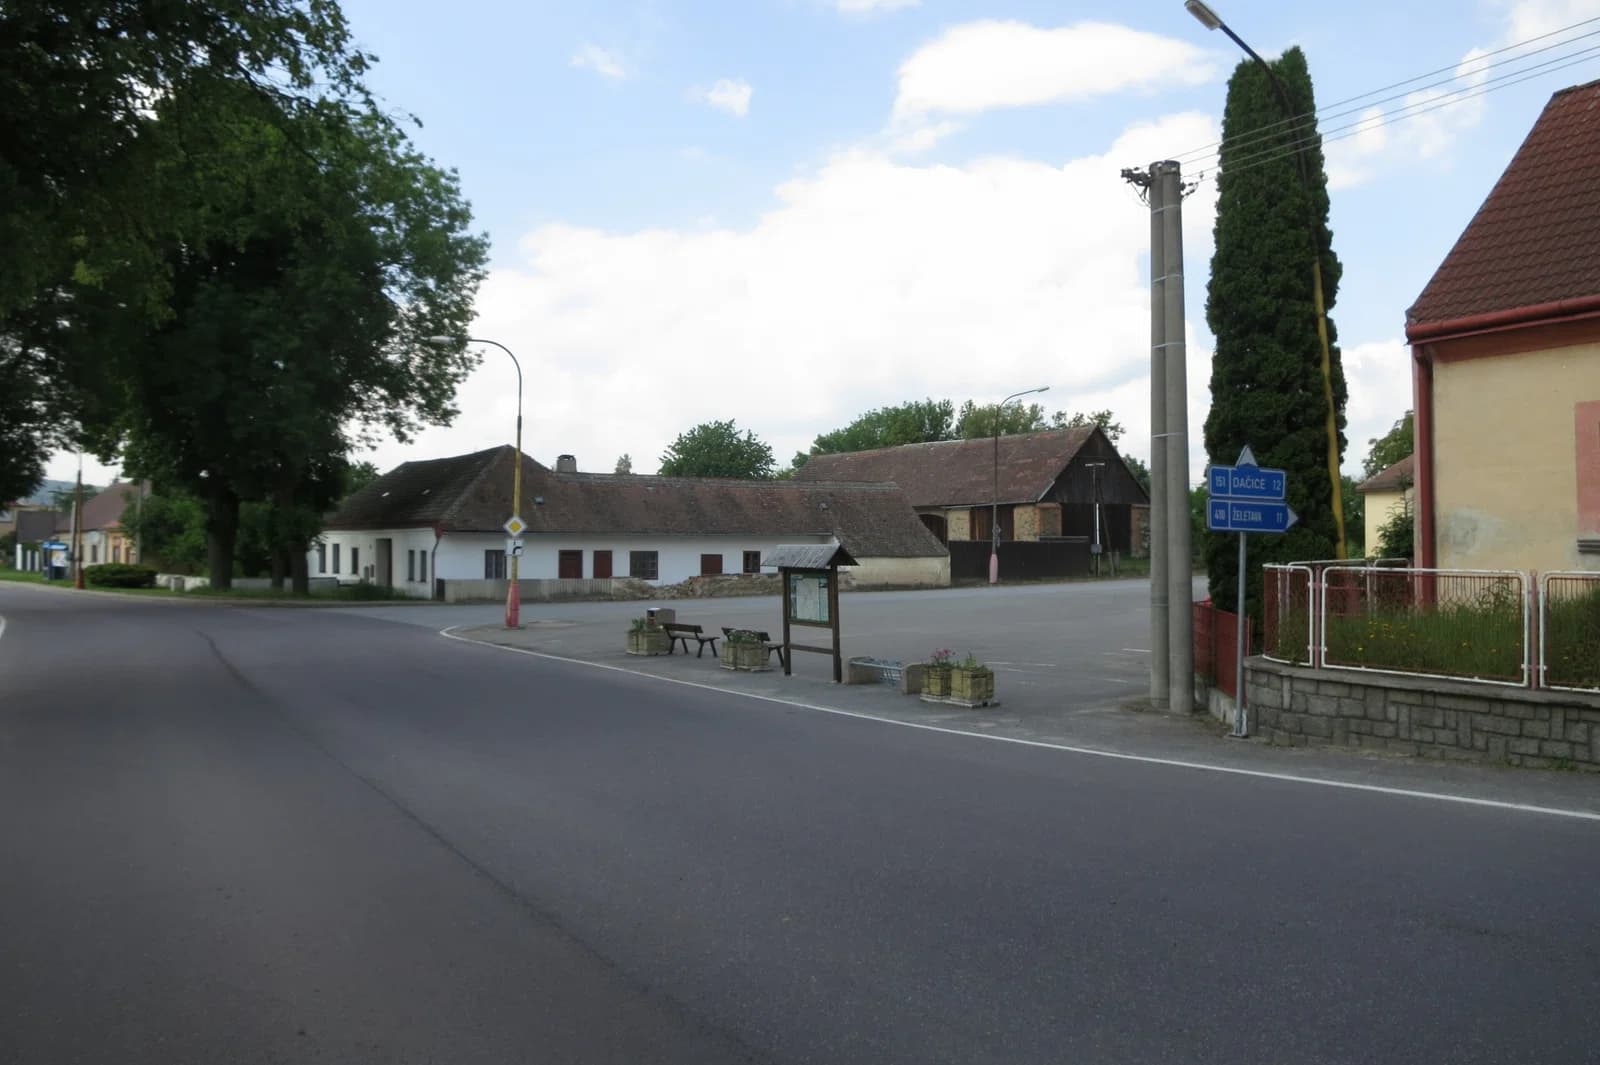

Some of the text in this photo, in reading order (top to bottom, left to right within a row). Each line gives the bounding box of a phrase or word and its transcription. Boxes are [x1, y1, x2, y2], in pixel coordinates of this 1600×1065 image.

[1233, 476, 1265, 489] DAČICE
[1272, 479, 1282, 491] 12
[1276, 511, 1283, 523] 11
